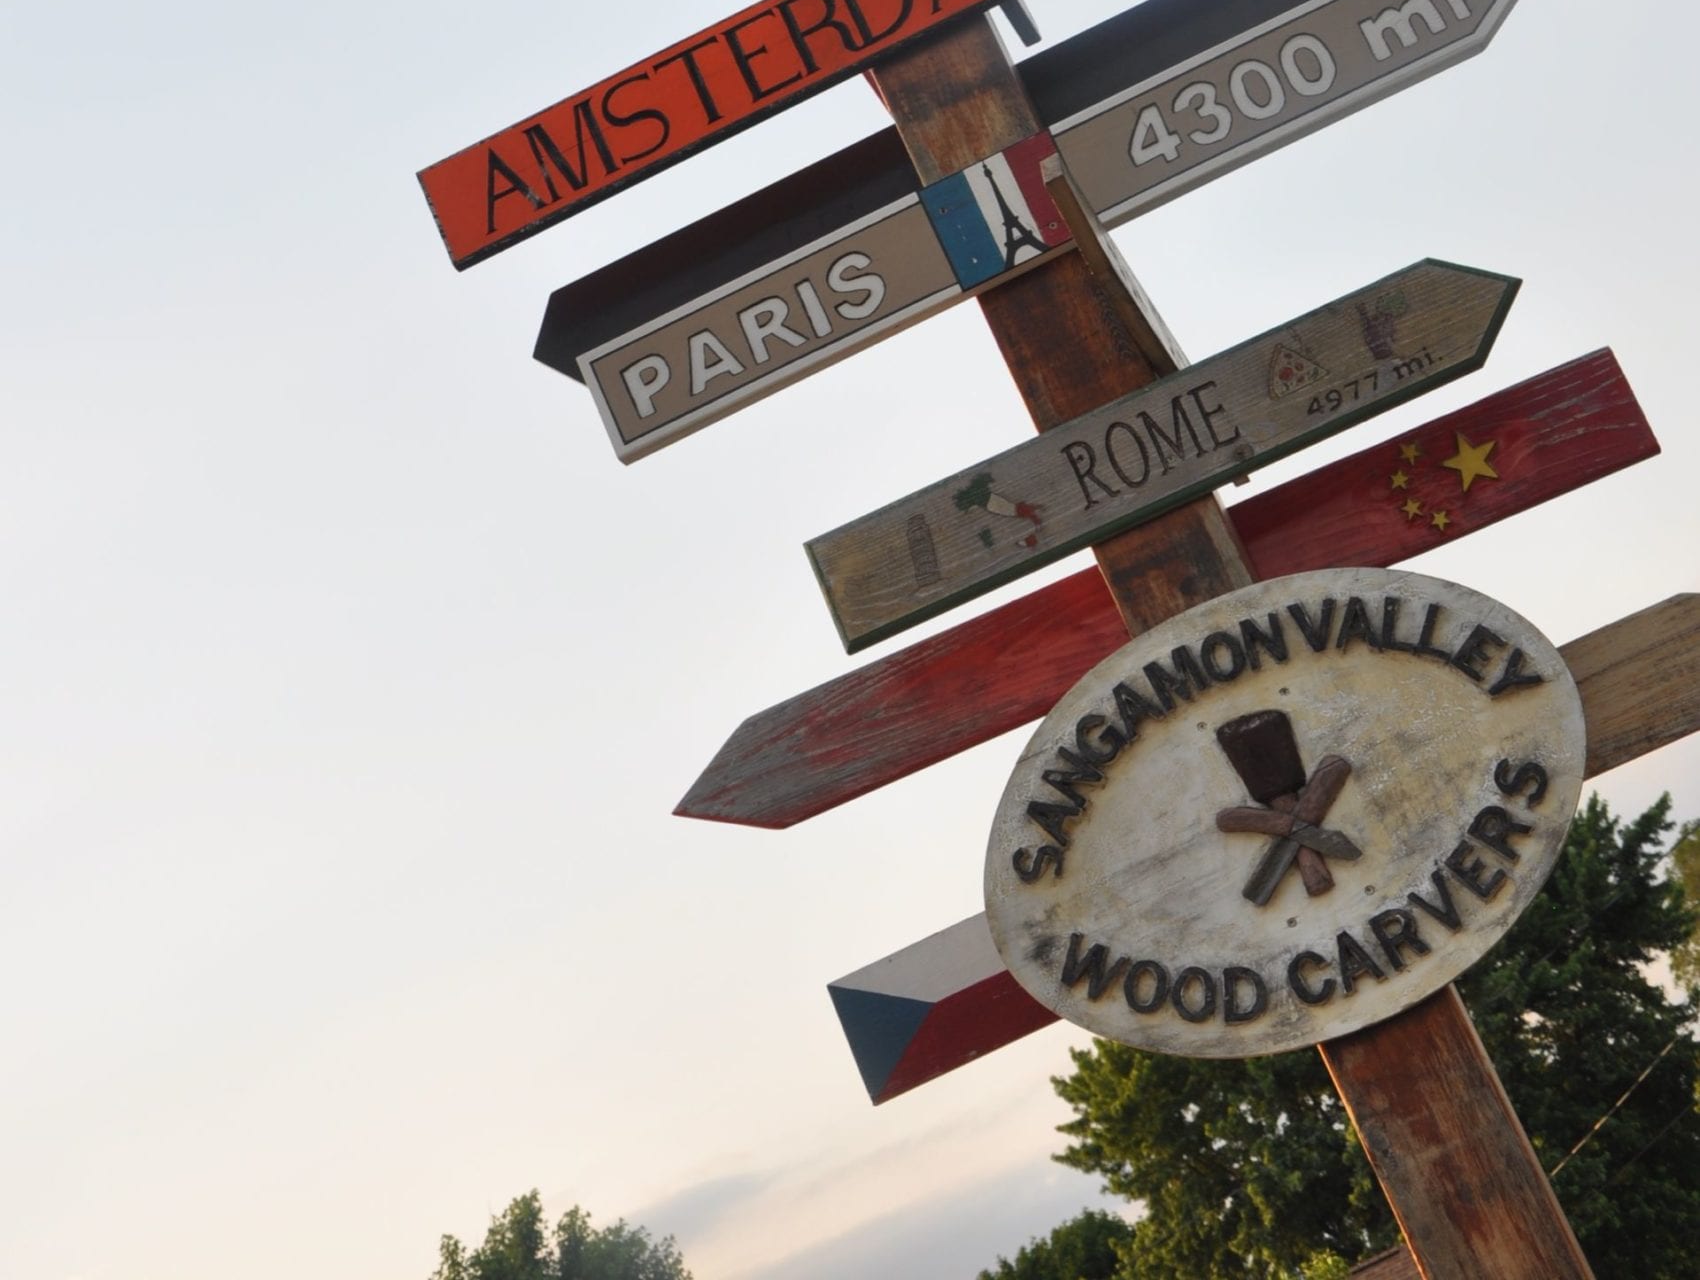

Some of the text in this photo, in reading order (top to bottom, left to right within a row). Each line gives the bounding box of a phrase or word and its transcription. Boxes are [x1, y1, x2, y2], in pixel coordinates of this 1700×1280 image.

[619, 250, 887, 420] PARIS
[1127, 31, 1337, 169] 4300
[1060, 346, 1444, 511] ROME 4977 mi.
[1012, 595, 1544, 886] SANGAMON VALLEY
[1060, 756, 1550, 1023] WOOD CARVERS
